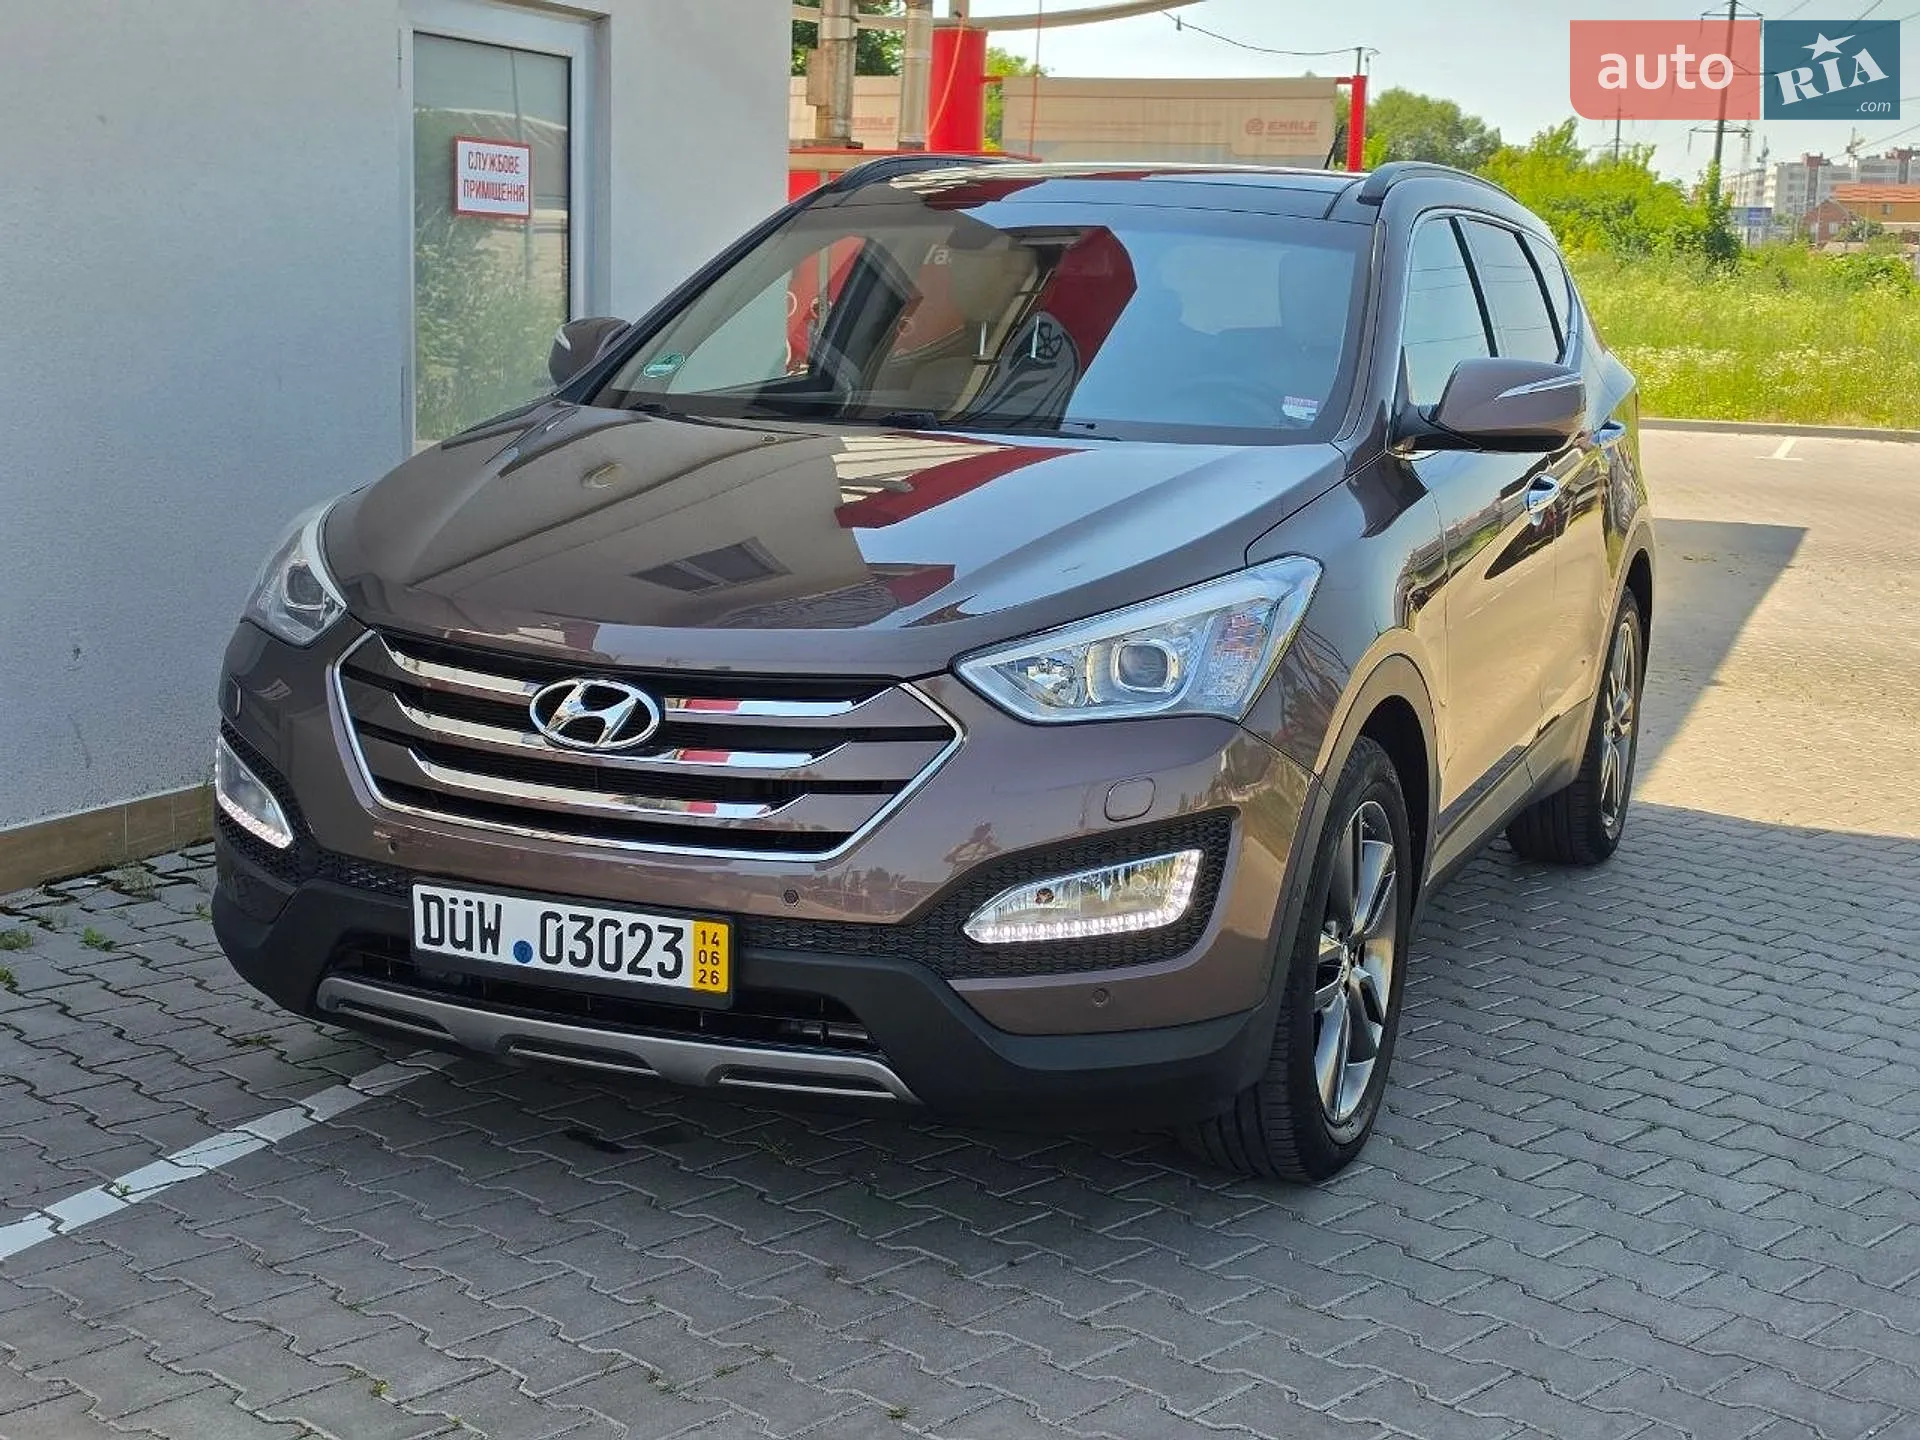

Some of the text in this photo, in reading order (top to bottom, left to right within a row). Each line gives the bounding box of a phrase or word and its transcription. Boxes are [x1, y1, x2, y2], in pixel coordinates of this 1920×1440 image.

[468, 151, 520, 174] СЛУЖБОВЕ
[463, 179, 525, 202] ПРИМІЩЕННЯ
[540, 910, 684, 980] 03023
[700, 929, 720, 947] 14
[698, 949, 720, 966] 06
[698, 968, 720, 985] 26
